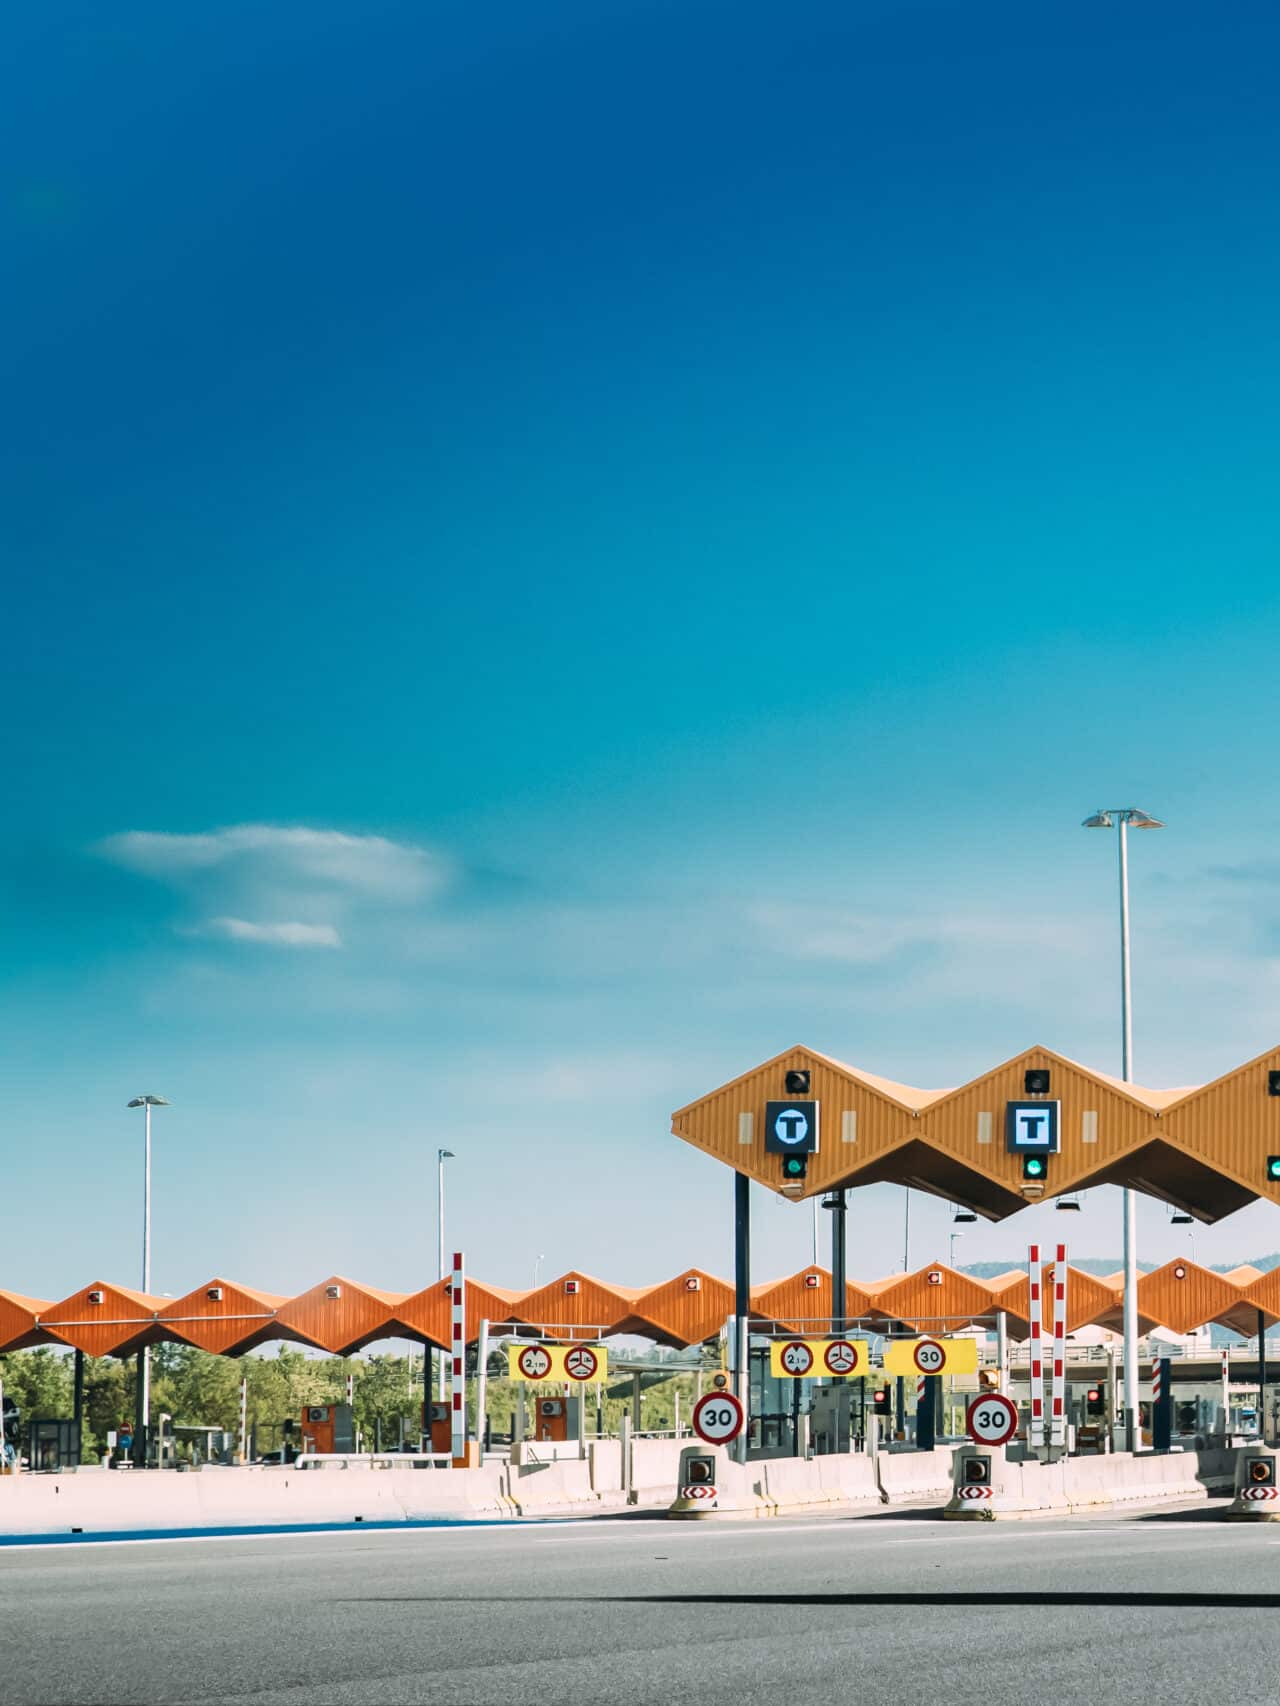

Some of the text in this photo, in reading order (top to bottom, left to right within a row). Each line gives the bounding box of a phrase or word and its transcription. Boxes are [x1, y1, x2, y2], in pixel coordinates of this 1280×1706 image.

[779, 1117, 804, 1139] T
[1020, 1117, 1045, 1139] T
[920, 1351, 940, 1363] 30
[705, 1409, 732, 1427] 30
[978, 1411, 1005, 1428] 30
